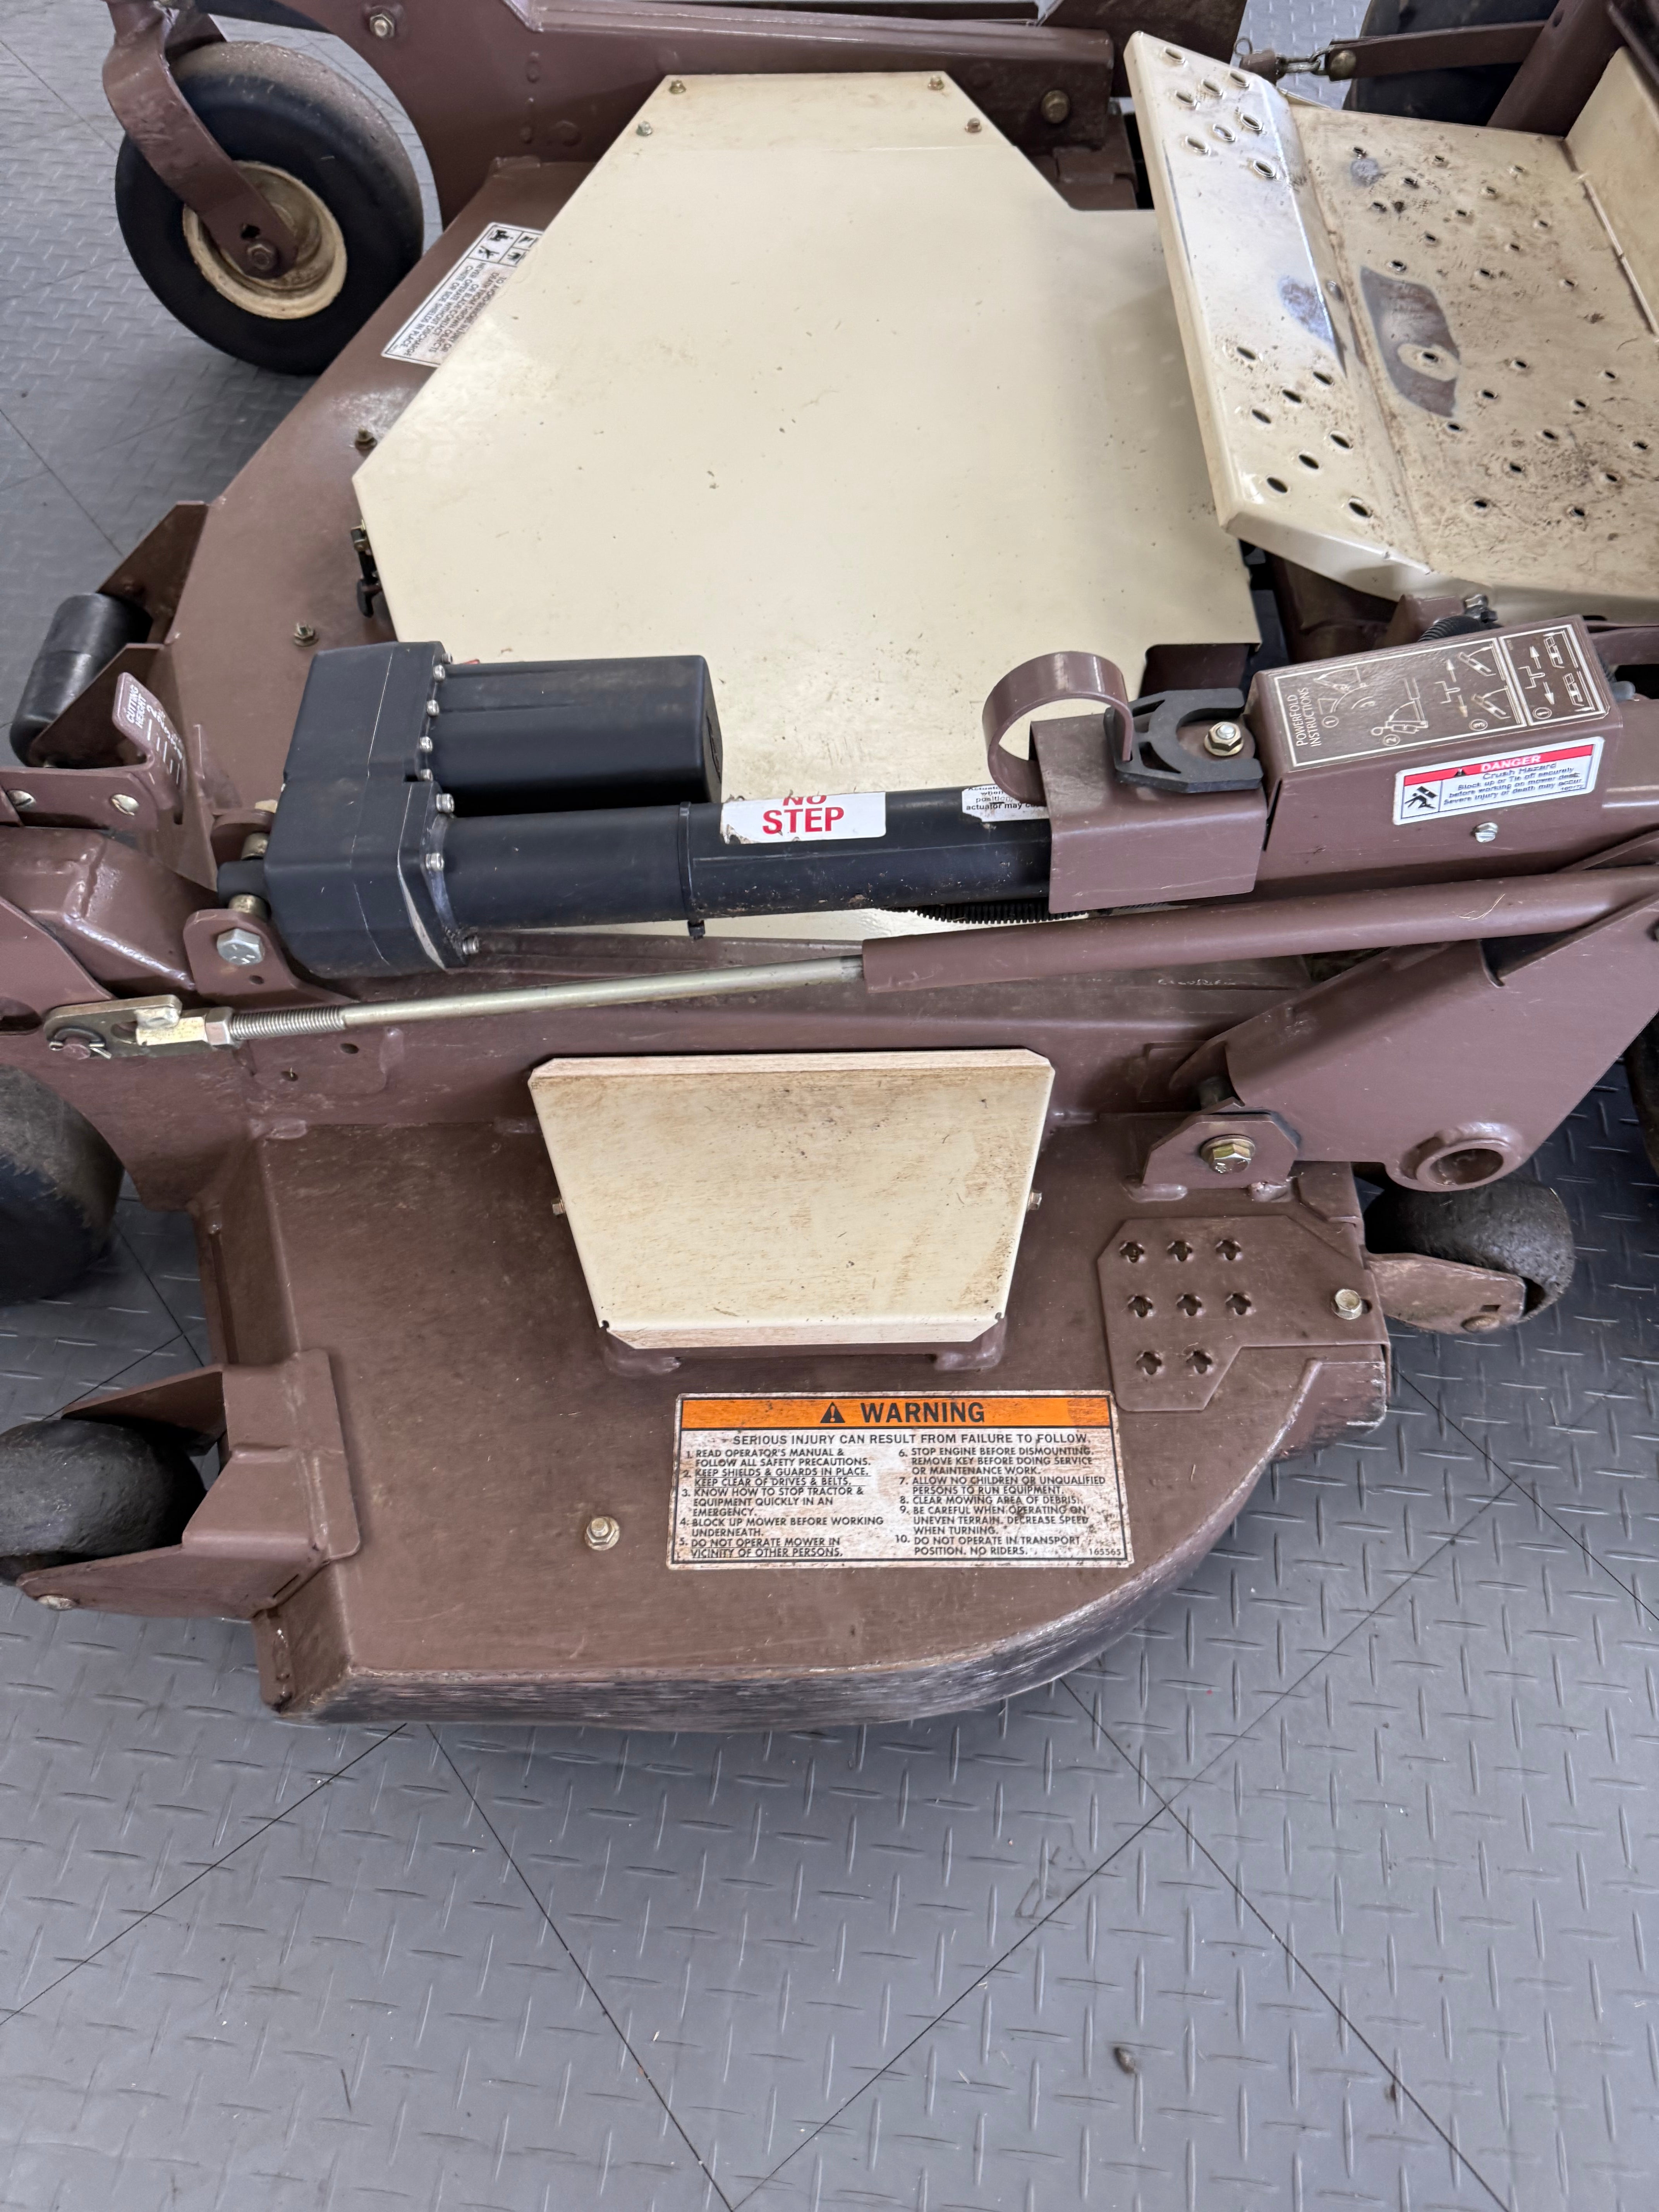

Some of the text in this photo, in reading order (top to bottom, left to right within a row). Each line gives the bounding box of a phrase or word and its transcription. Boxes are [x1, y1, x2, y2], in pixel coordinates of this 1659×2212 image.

[456, 265, 473, 281] CHUTE
[438, 291, 452, 302] SIDE
[454, 292, 472, 309] BLADE
[404, 262, 486, 356] NEVER OPERATE WITHOUT DISCHARGE
[421, 303, 442, 322] SHIELDS
[433, 309, 458, 335] CONTACT
[125, 684, 139, 724] CUTTING
[135, 693, 147, 729] HEIGHT
[147, 704, 157, 718] 2
[1287, 694, 1309, 747] POWERFOLD
[1300, 687, 1322, 747] INSTRUCTIONS
[1481, 755, 1540, 771] DANGER
[1482, 763, 1556, 780] Crush Hazard
[1458, 782, 1480, 790] Block
[1538, 767, 1573, 776] securely
[1478, 784, 1511, 792] working
[782, 795, 827, 806] NO
[1443, 797, 1471, 805] Severe
[763, 807, 844, 835] STEP
[860, 1401, 985, 1423] WARNING
[732, 1435, 787, 1444] SERIOUS
[792, 1435, 834, 1444] INJURY
[840, 1435, 864, 1444] CAN
[870, 1434, 915, 1444] RESULT
[921, 1434, 956, 1443] FROM
[961, 1434, 1012, 1443] FAILURE
[1017, 1434, 1032, 1443] TO
[940, 1447, 976, 1455] ENGINE
[696, 1458, 871, 1467] FOLLOW ALL SAFETY PRECAUTIONS.
[695, 1468, 718, 1476] KEEP
[722, 1468, 761, 1476] SHIELDS
[776, 1468, 817, 1476] GUARDS
[821, 1468, 831, 1476] IN
[836, 1468, 868, 1476] PLACE.
[929, 1467, 1002, 1475] MAINTENANCE
[695, 1478, 718, 1486] KEEP
[771, 1477, 805, 1486] DRIVES
[912, 1477, 946, 1485] ALLOW
[950, 1477, 966, 1485] NO
[970, 1476, 1017, 1484] CHILDREN
[1022, 1476, 1036, 1484] OR
[1040, 1476, 1106, 1484] UNQUALIFIED
[694, 1487, 728, 1496] KNOW
[732, 1487, 759, 1496] HOW
[779, 1487, 803, 1495] STOP
[807, 1487, 852, 1495] TRACTOR
[978, 1486, 1000, 1494] RUN
[694, 1497, 833, 1506] EQUIPMENT QUICKLY IN AN
[913, 1496, 942, 1504] CLEAR
[946, 1496, 993, 1504] MOWING
[996, 1496, 1022, 1504] AREA
[693, 1508, 757, 1516] EMERGENCY.
[913, 1506, 925, 1514] BE
[929, 1506, 970, 1514] CAREFUL
[974, 1506, 1005, 1514] WHEN
[1009, 1506, 1066, 1514] OPERATING
[1070, 1505, 1087, 1513] ON
[692, 1518, 725, 1526] BLOCK
[728, 1518, 742, 1526] UP
[746, 1517, 786, 1526] MOWER
[791, 1517, 826, 1525] BEFORE
[831, 1517, 884, 1525] WORKING
[914, 1516, 955, 1525] UNEVEN
[1007, 1516, 1056, 1524] DECREASE
[1059, 1516, 1089, 1524] SPEED
[692, 1528, 764, 1537] UNDERNEATH.
[914, 1526, 999, 1535] WHEN TURNING.
[679, 1537, 840, 1546] 5. DO NOT OPERATE MOWER IN
[894, 1535, 1080, 1545] 10. DO NOT OPERATE IN TRANSPORT
[691, 1548, 788, 1557] VICINITY OF OTHER
[915, 1546, 1028, 1556] POSITION. NO RIDERS.
